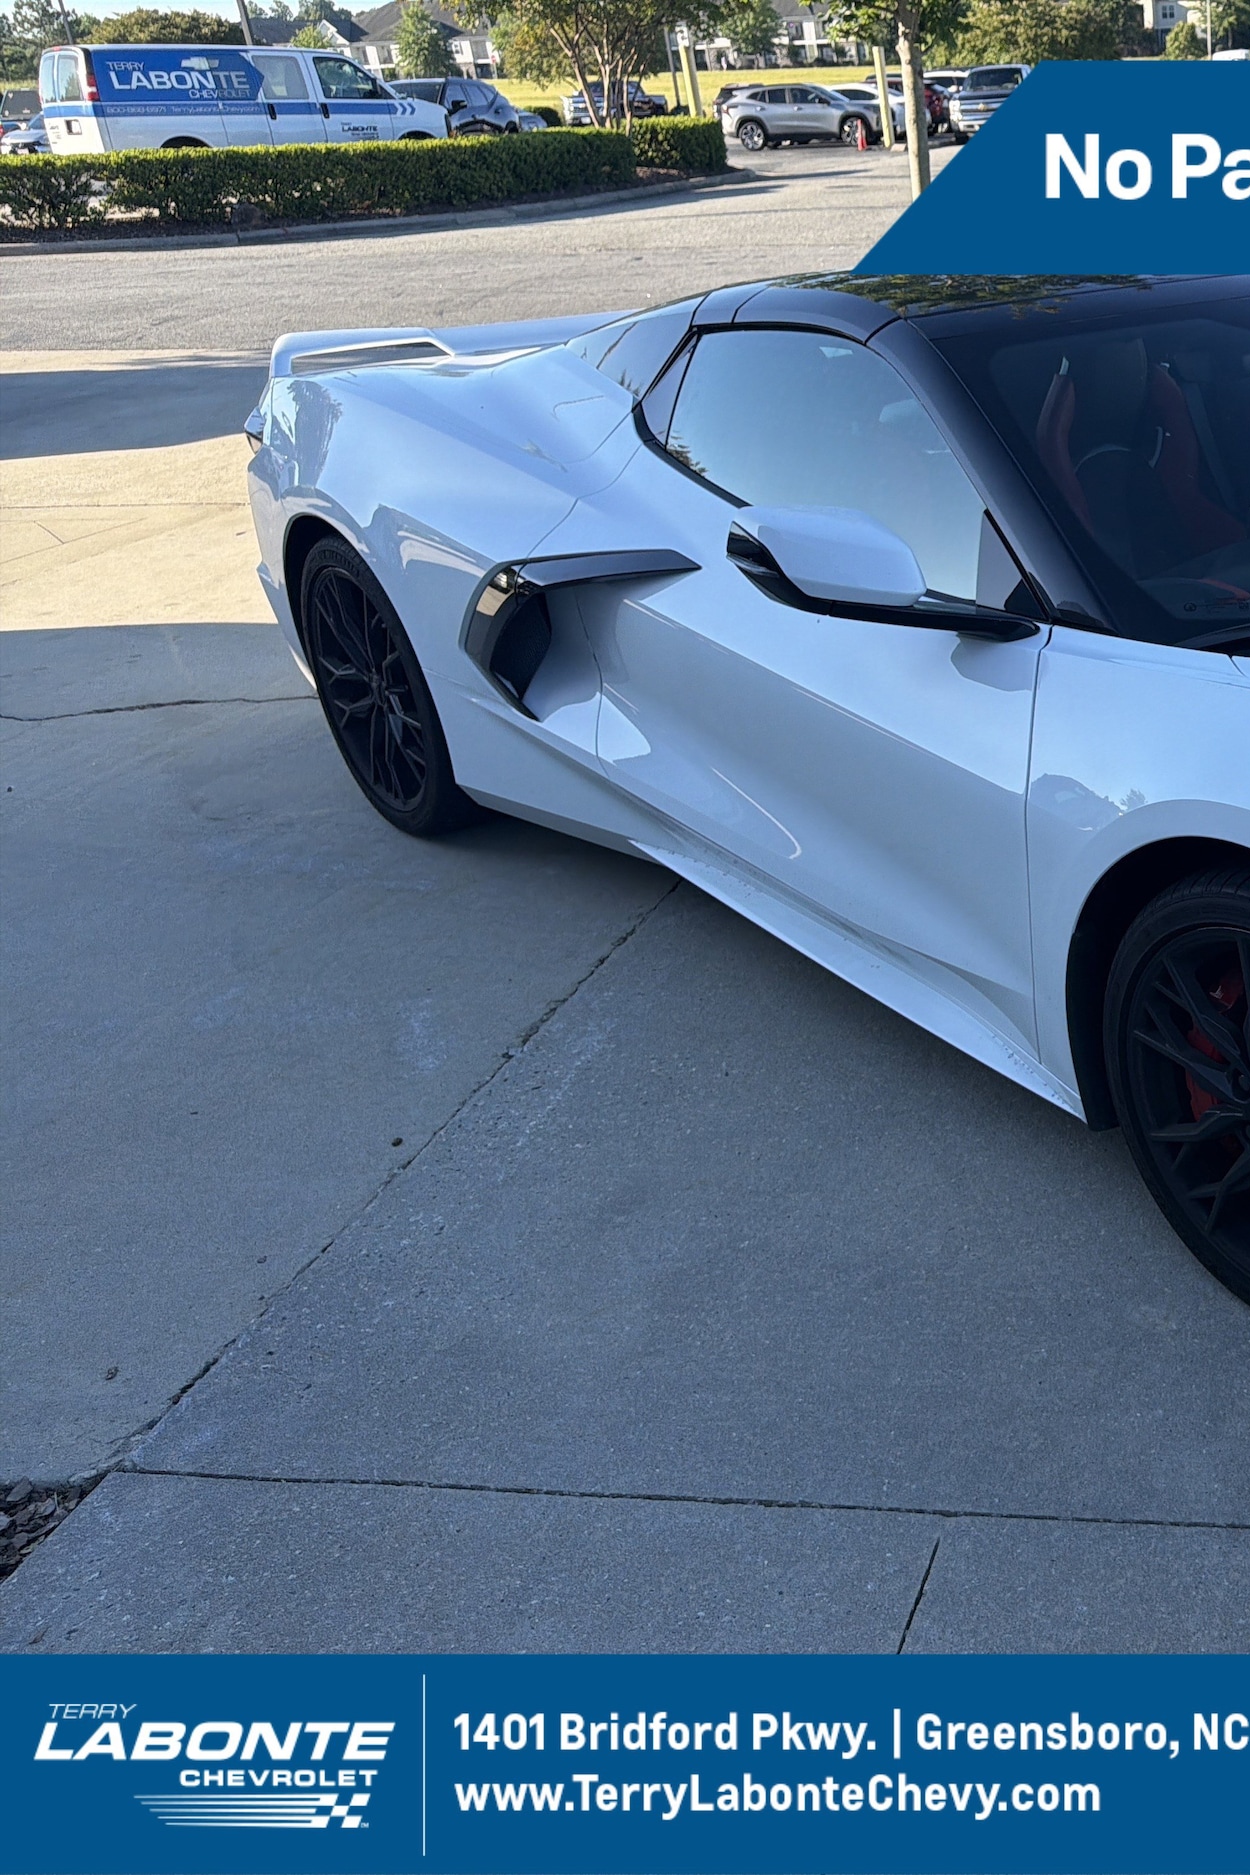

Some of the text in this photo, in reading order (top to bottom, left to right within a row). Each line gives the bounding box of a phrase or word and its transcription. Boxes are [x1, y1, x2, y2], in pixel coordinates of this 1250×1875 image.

[106, 61, 144, 71] TERRY
[109, 71, 249, 90] LABONTE
[188, 88, 250, 99] CHEVROLET
